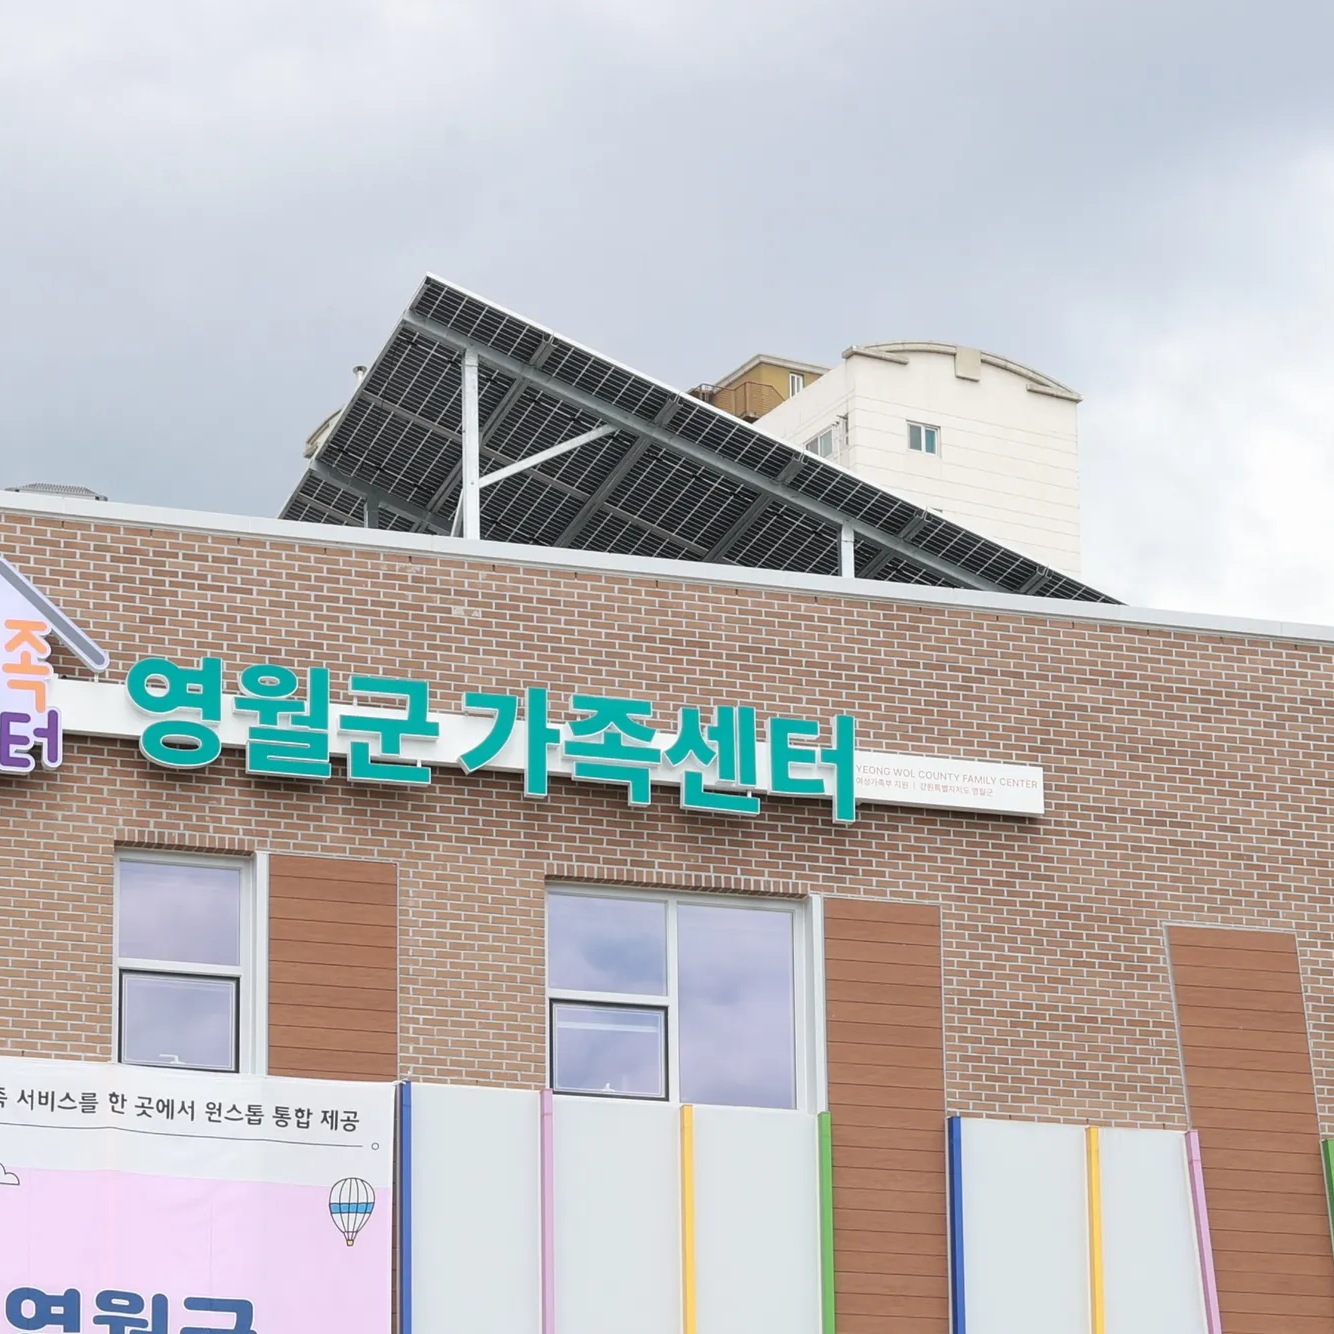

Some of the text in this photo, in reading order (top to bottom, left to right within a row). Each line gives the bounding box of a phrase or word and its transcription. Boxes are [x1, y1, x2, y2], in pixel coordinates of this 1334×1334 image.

[856, 764, 1038, 789] YEONG WOL COUNTY FAMILY CENTER
[856, 777, 994, 798] 여성가족부 지원 강원특별자치도 영월군
[16, 1089, 99, 1114] 서비스를
[108, 1091, 127, 1115] 한
[134, 1096, 195, 1122] 곳에서
[205, 1102, 265, 1125] 원스톱
[272, 1105, 313, 1129] 통합
[320, 1109, 360, 1132] 제공
